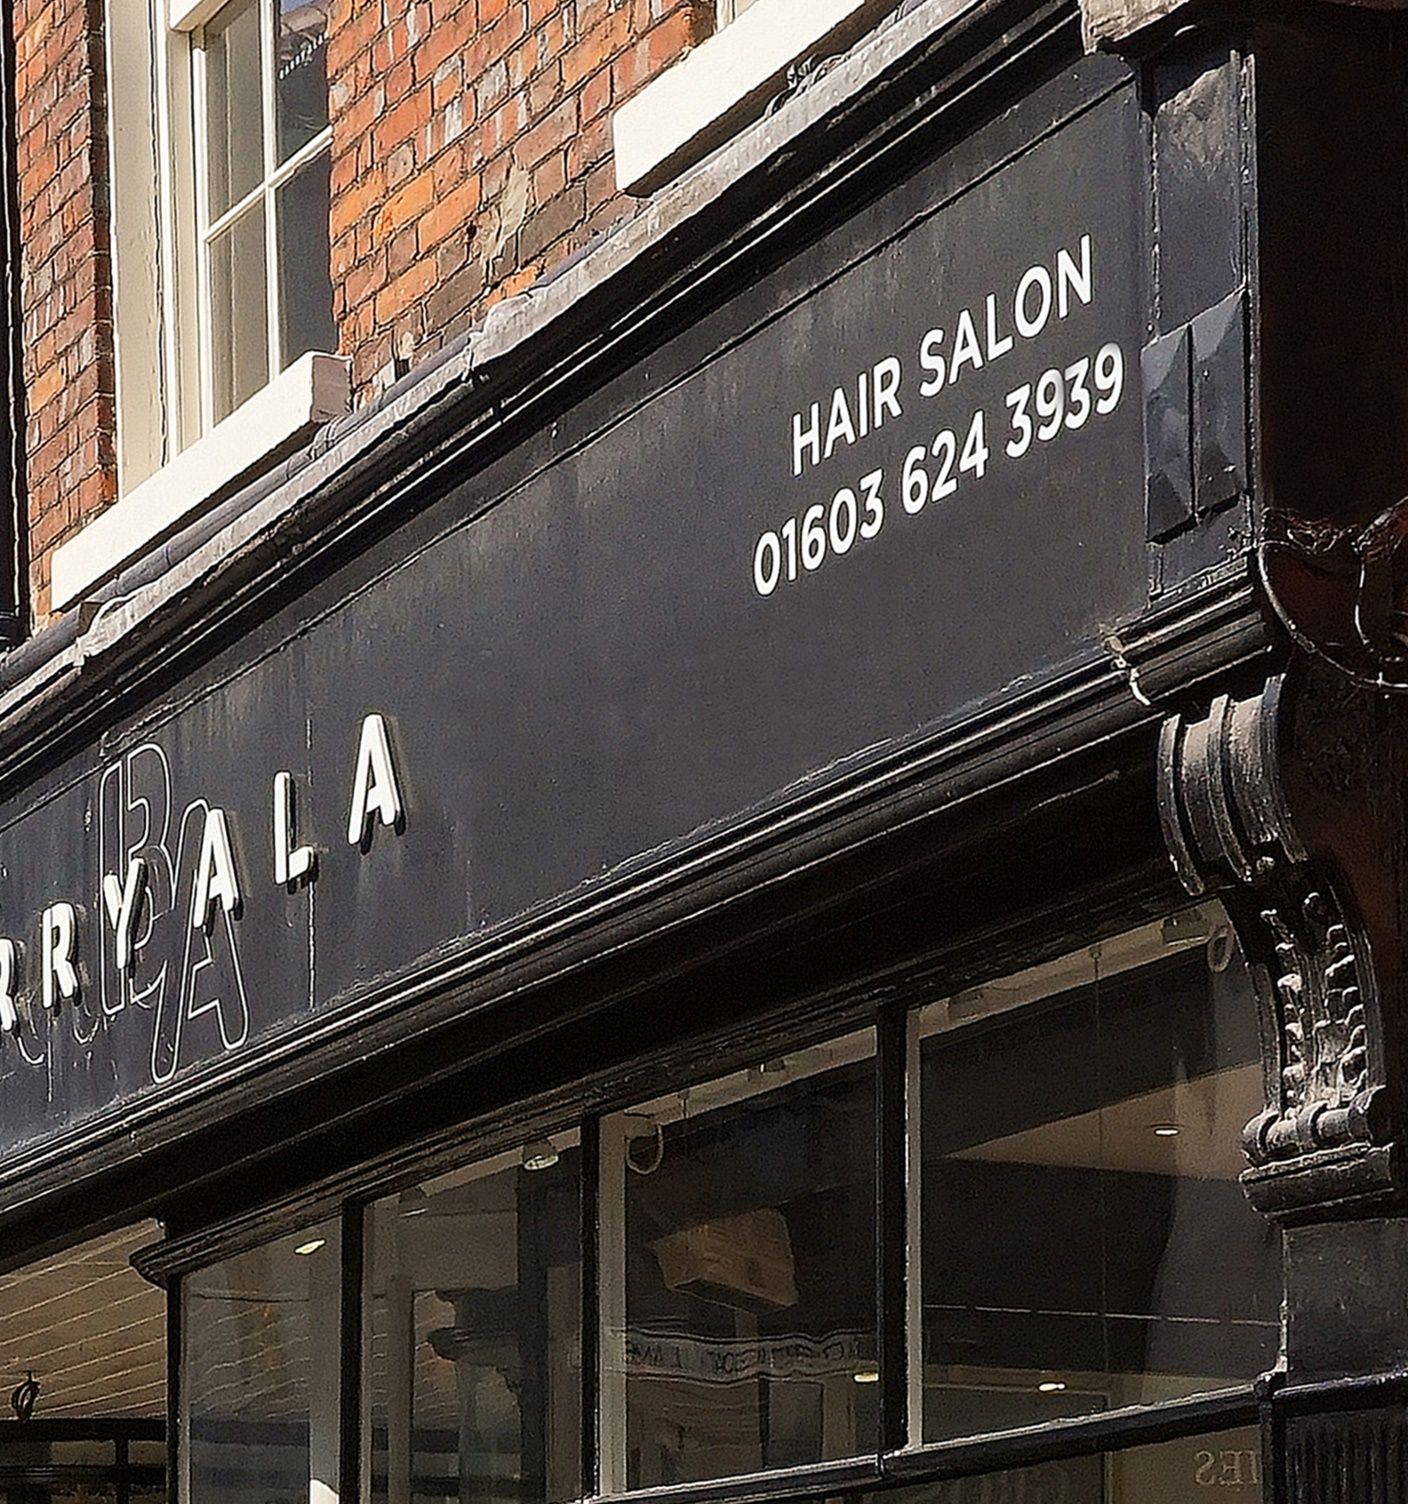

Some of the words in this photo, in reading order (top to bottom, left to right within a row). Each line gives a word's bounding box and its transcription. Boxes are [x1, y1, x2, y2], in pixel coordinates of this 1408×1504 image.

[752, 468, 884, 597] 01603
[900, 411, 989, 515] 624
[1004, 341, 1124, 458] 3939
[791, 356, 901, 476] HAIR
[919, 235, 1092, 398] SALON
[192, 713, 403, 928] ALA
